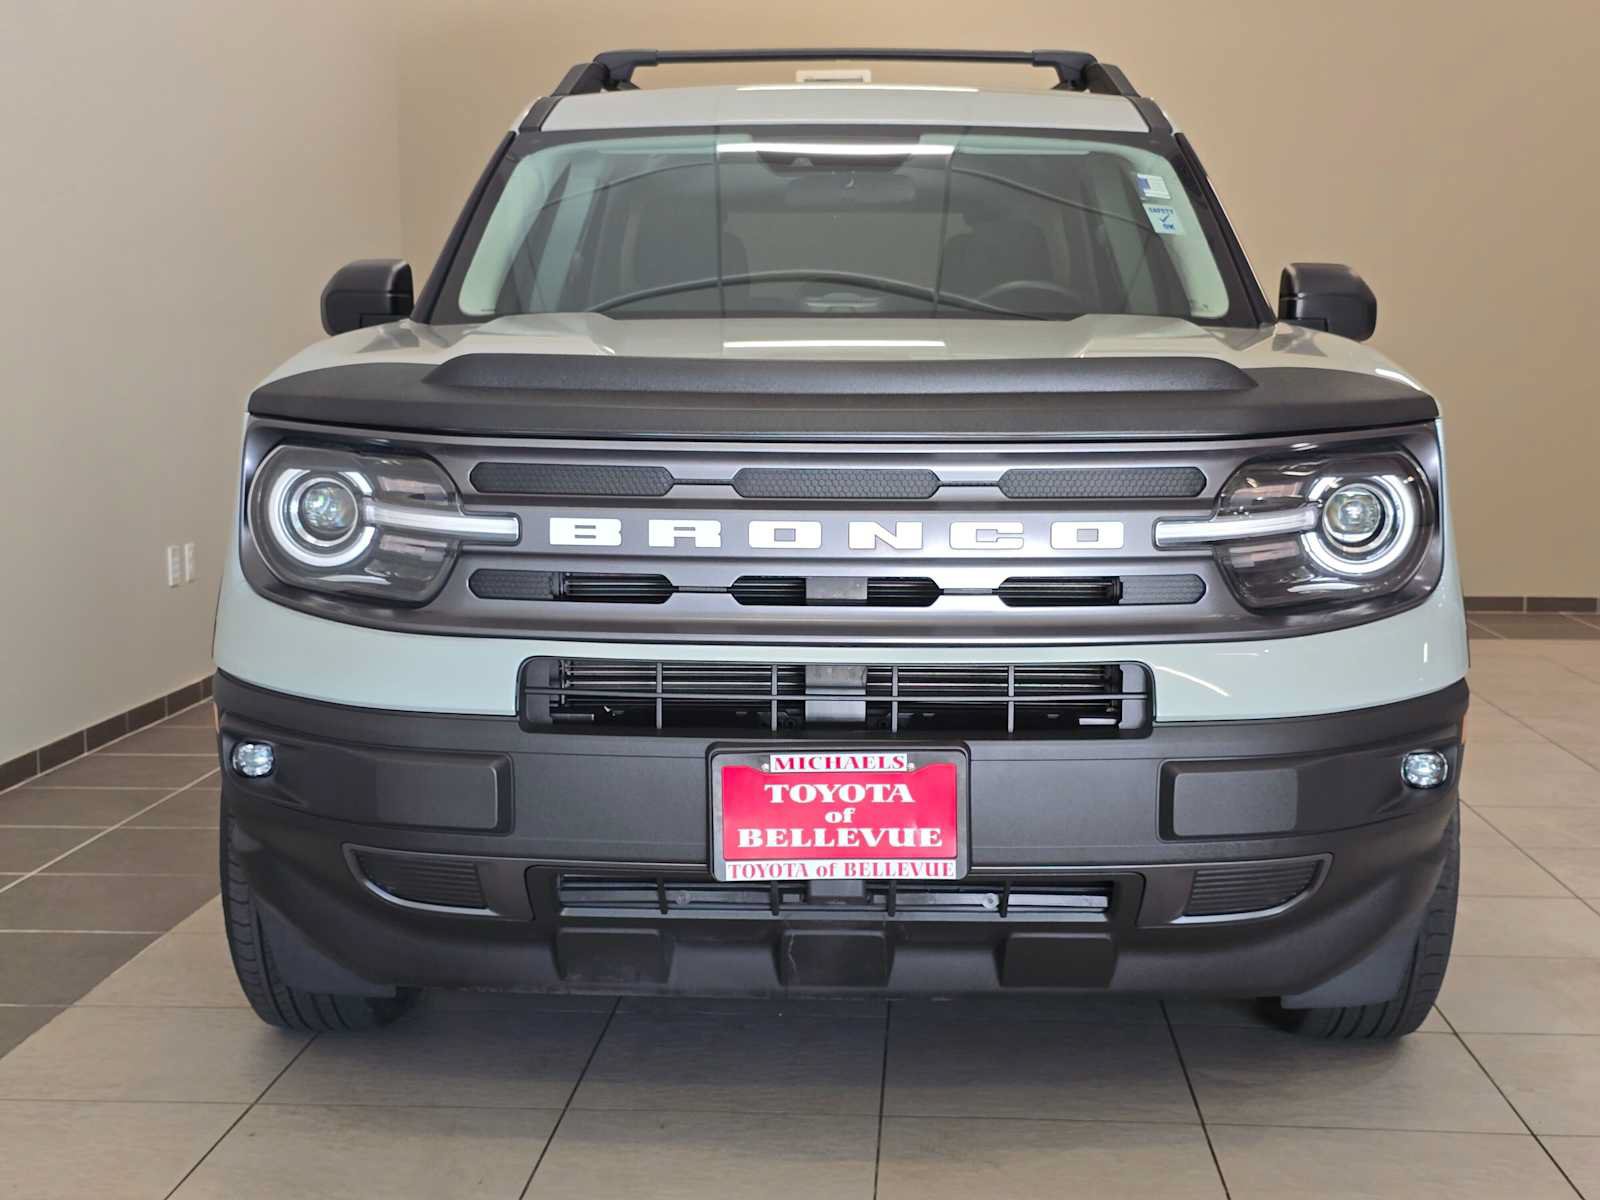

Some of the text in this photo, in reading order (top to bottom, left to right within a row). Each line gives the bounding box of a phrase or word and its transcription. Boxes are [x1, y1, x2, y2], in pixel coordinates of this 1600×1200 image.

[549, 517, 1124, 550] BRONCO
[774, 755, 905, 770] MICHAELS
[764, 783, 915, 804] TOYOTA
[824, 808, 856, 824] of
[737, 828, 943, 848] BELLEVUE
[728, 862, 954, 879] TOYOTA of BELLEVUE
